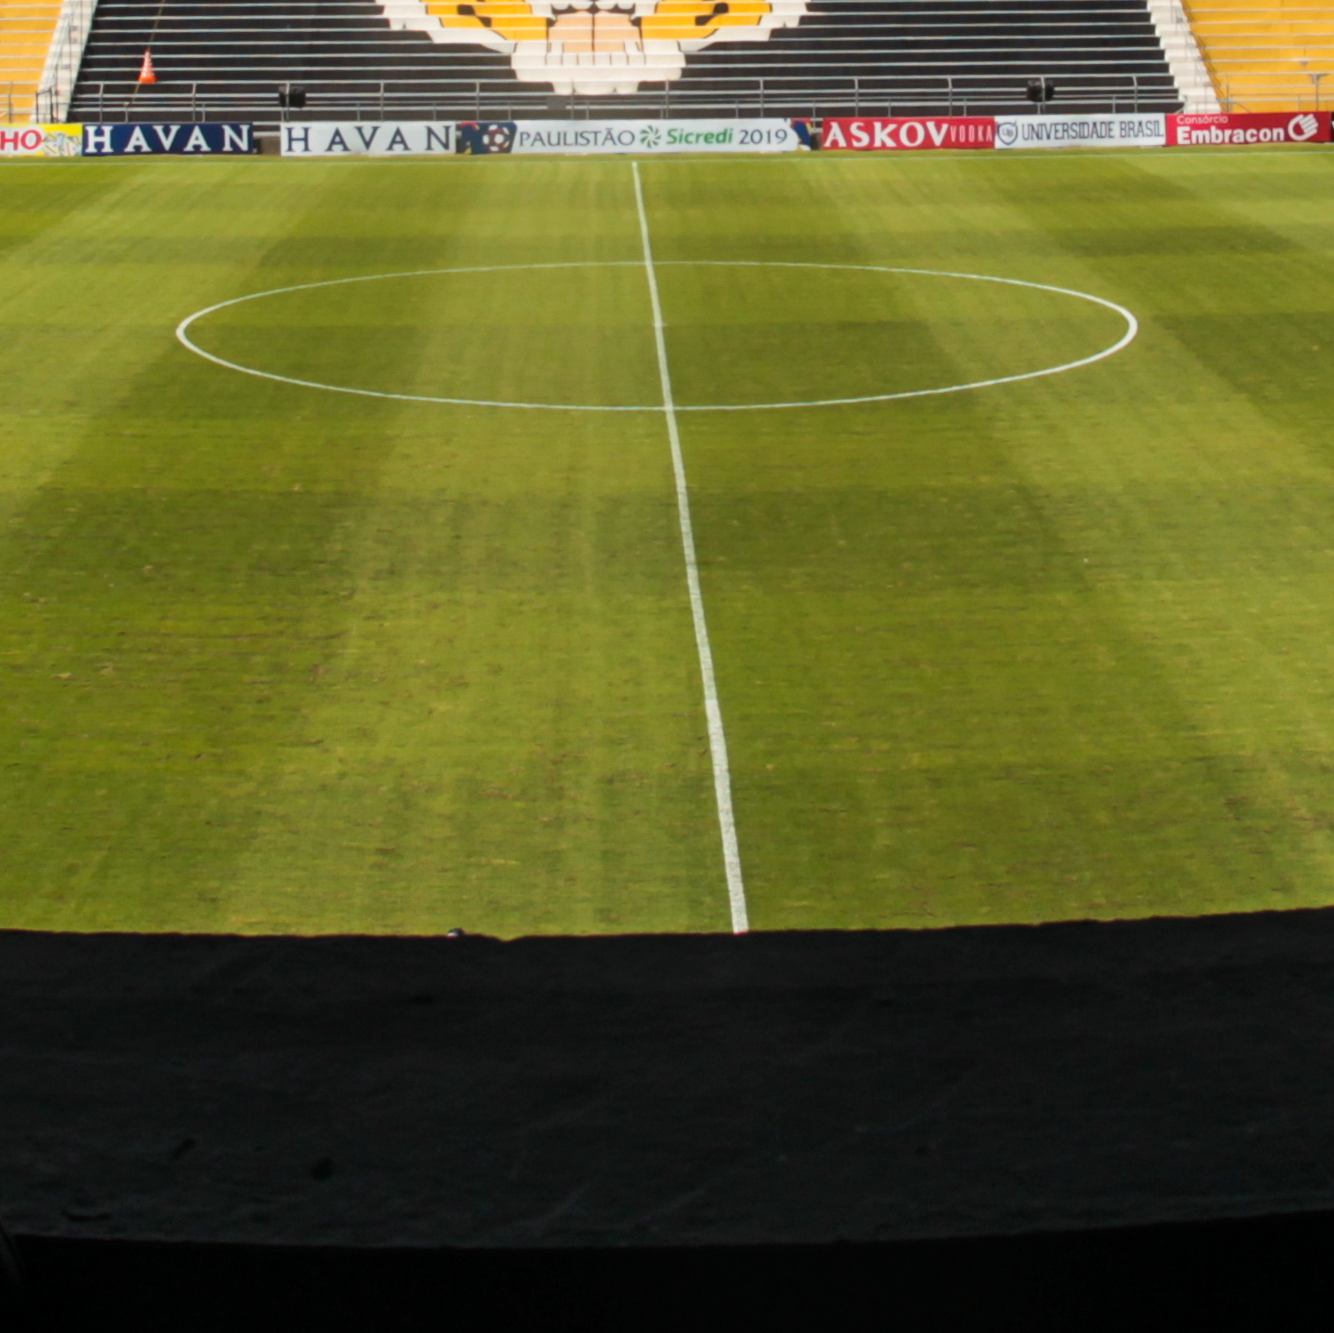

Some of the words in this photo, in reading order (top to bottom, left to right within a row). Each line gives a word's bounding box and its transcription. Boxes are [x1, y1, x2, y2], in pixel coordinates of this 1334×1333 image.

[1022, 121, 1115, 141] UNIVERSIDADE
[1119, 120, 1164, 139] BRASIL
[1176, 114, 1229, 125] Consórcio
[85, 124, 251, 154] HAVAN
[286, 125, 452, 153] HAVAN
[519, 127, 636, 147] PAULISTÃO
[666, 125, 733, 145] Sicredi
[738, 128, 788, 145] 2019
[824, 121, 949, 148] ASKOV
[950, 123, 993, 144] VODKA
[1176, 126, 1285, 145] Embracon
